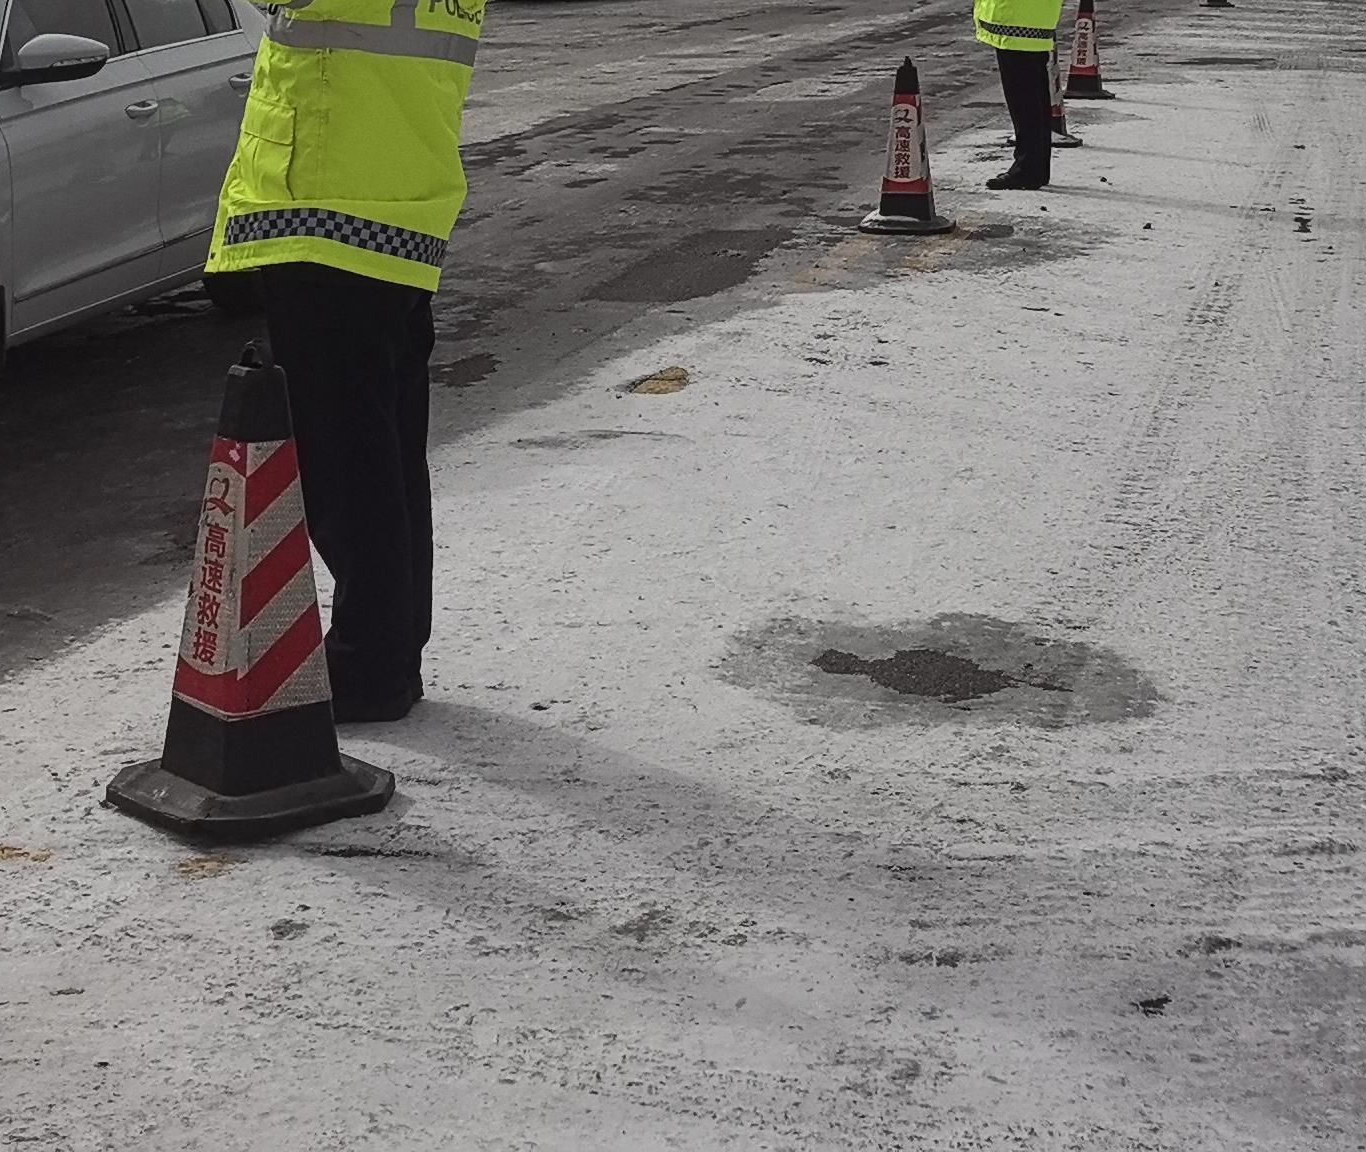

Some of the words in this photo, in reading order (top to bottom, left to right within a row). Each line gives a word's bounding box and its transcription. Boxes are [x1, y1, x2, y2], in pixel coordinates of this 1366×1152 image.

[894, 126, 911, 179] 高速救援
[192, 522, 229, 666] 高速救援
